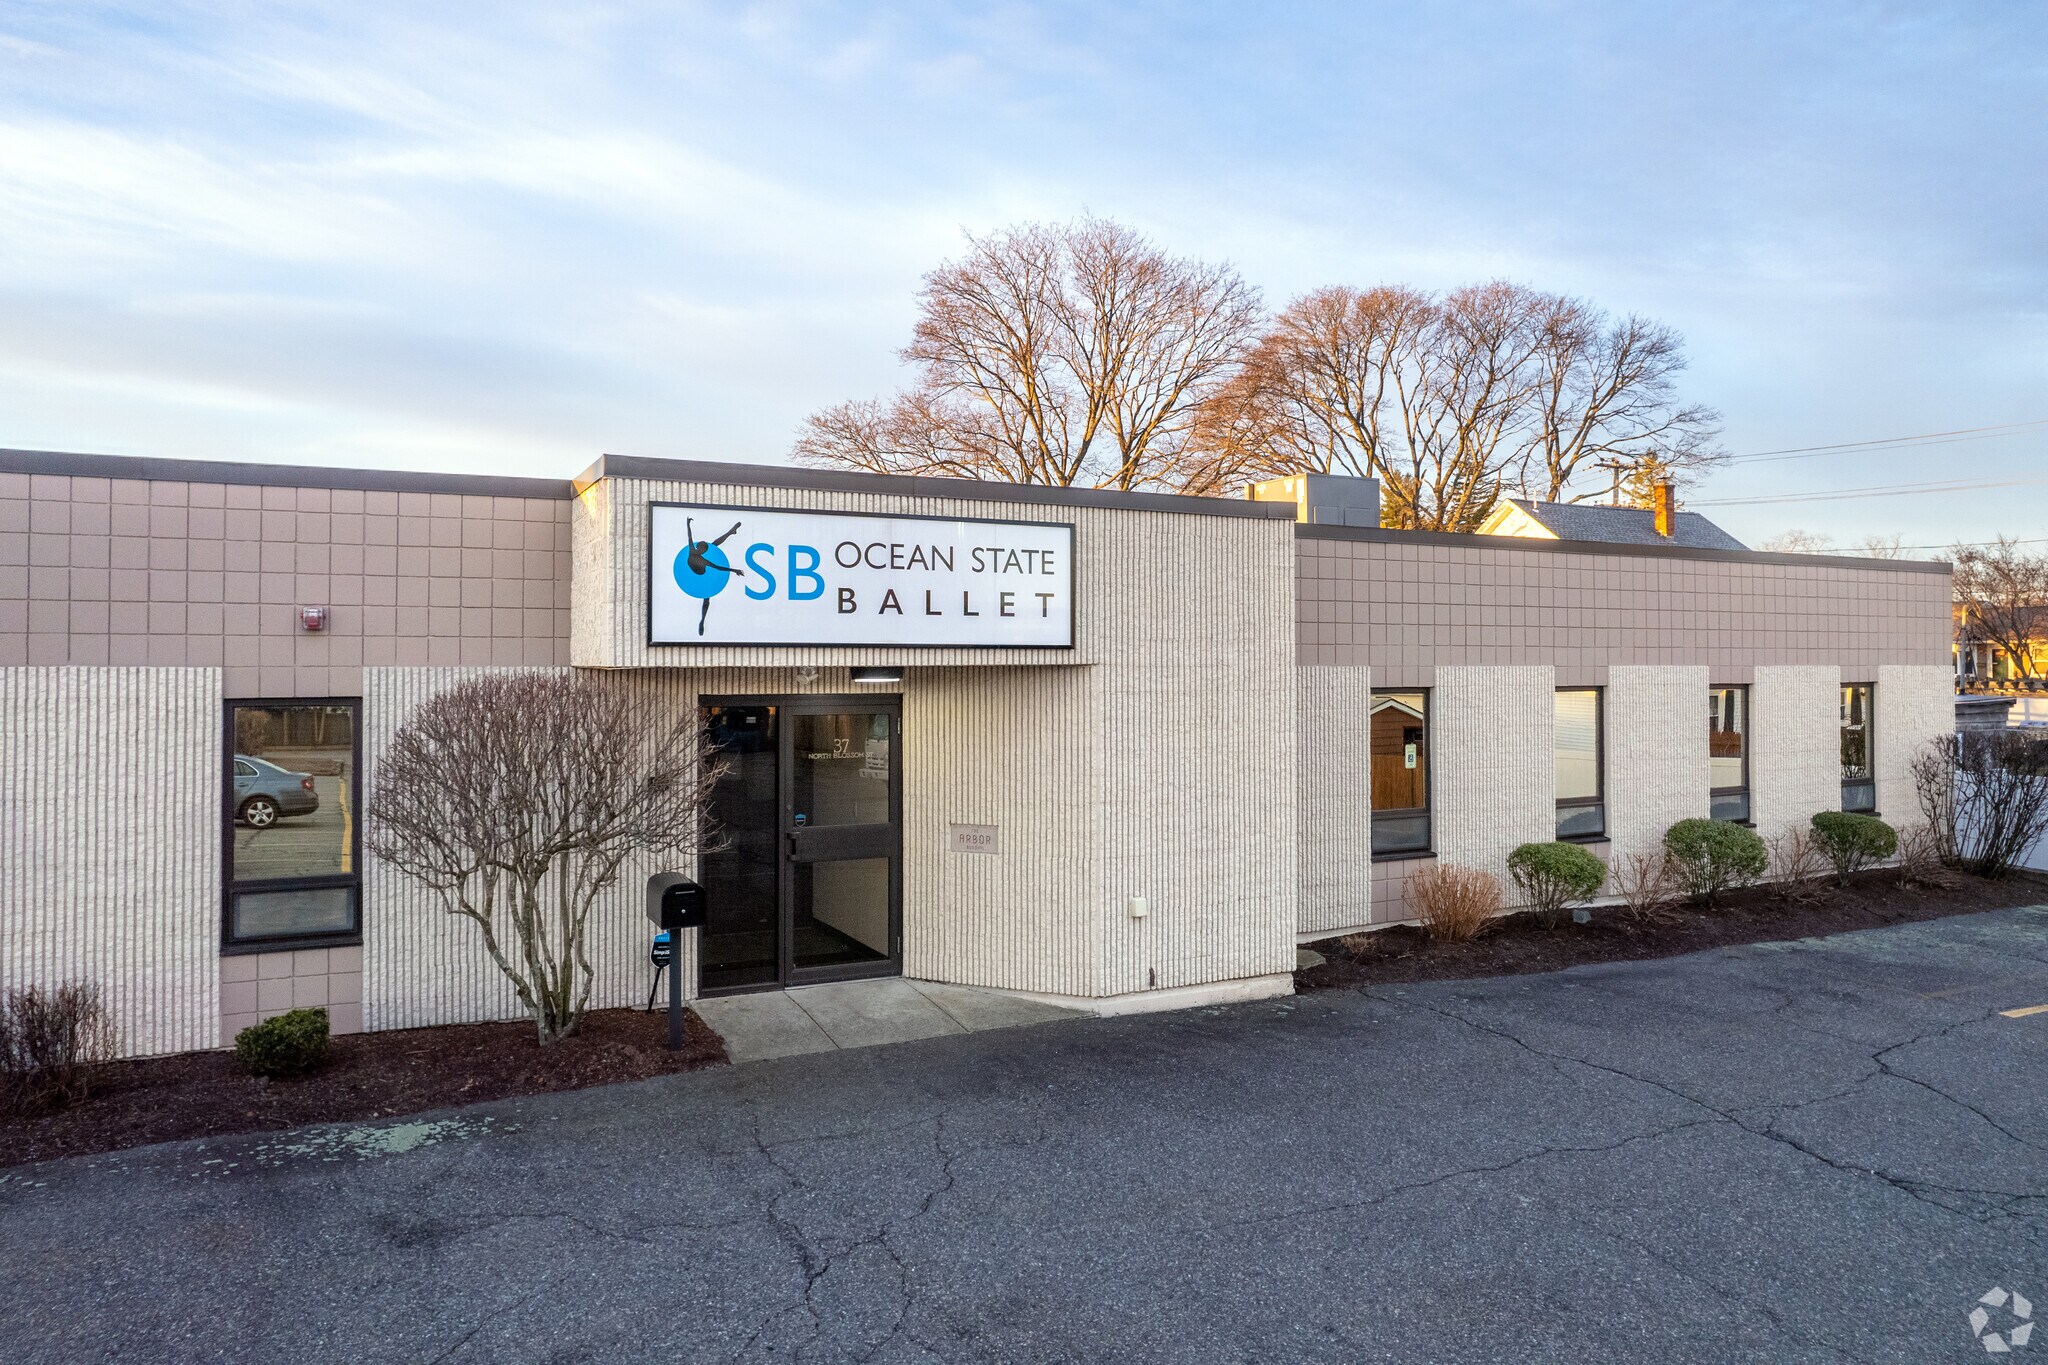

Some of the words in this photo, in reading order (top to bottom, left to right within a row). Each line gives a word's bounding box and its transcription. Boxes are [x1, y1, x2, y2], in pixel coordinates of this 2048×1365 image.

[834, 541, 954, 572] OCEAN
[971, 546, 1055, 575] STATE
[837, 587, 1055, 618] BALLET
[833, 738, 849, 753] 37
[833, 751, 864, 759] BLOSSOM
[959, 833, 991, 844] ARBOR
